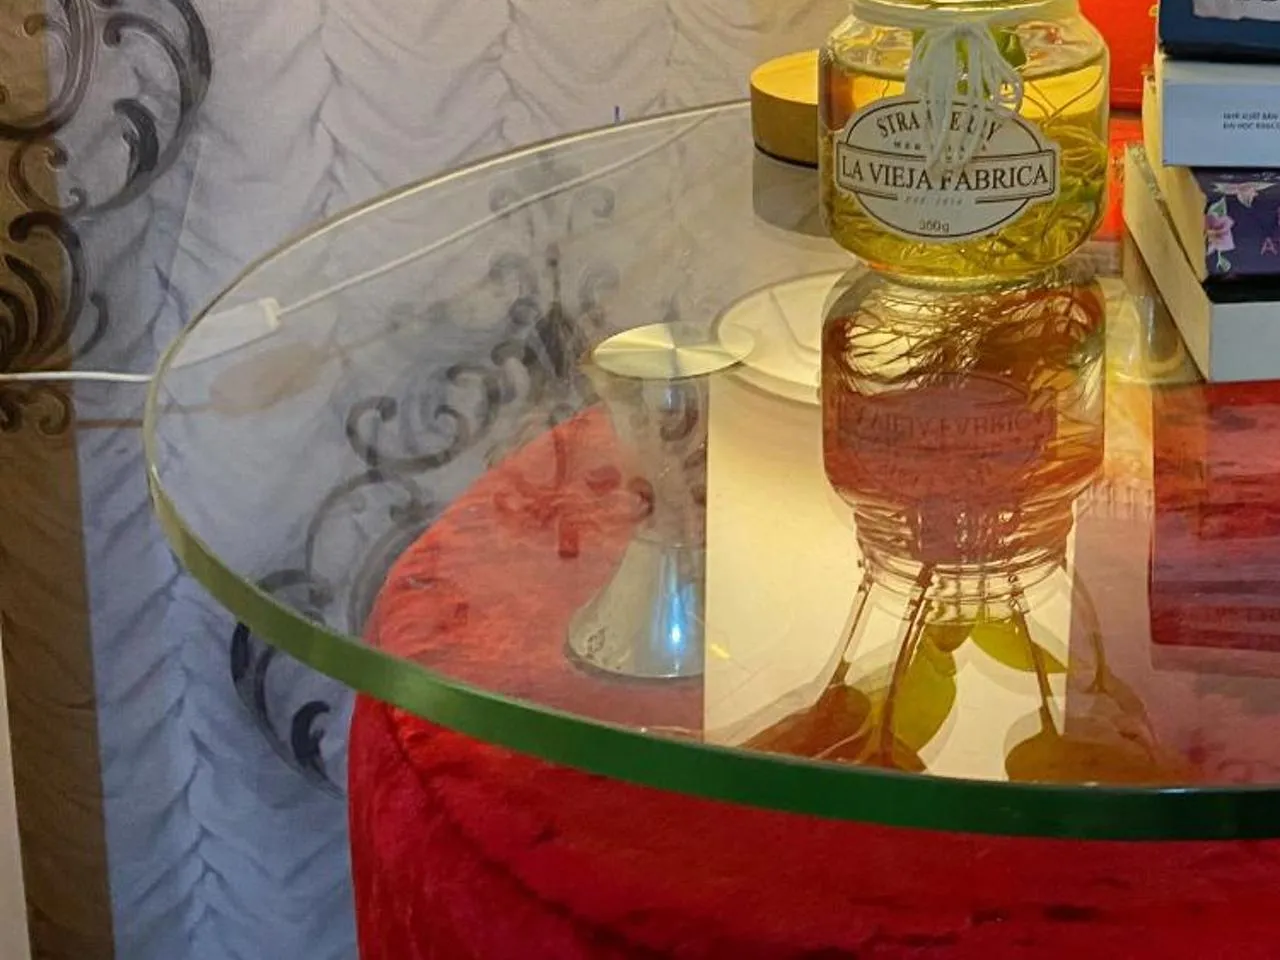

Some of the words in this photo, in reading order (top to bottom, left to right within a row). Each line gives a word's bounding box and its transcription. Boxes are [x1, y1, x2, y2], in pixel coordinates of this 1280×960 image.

[841, 155, 864, 181] LA
[868, 162, 933, 190] VIEJA
[940, 163, 1049, 191] FABRICA
